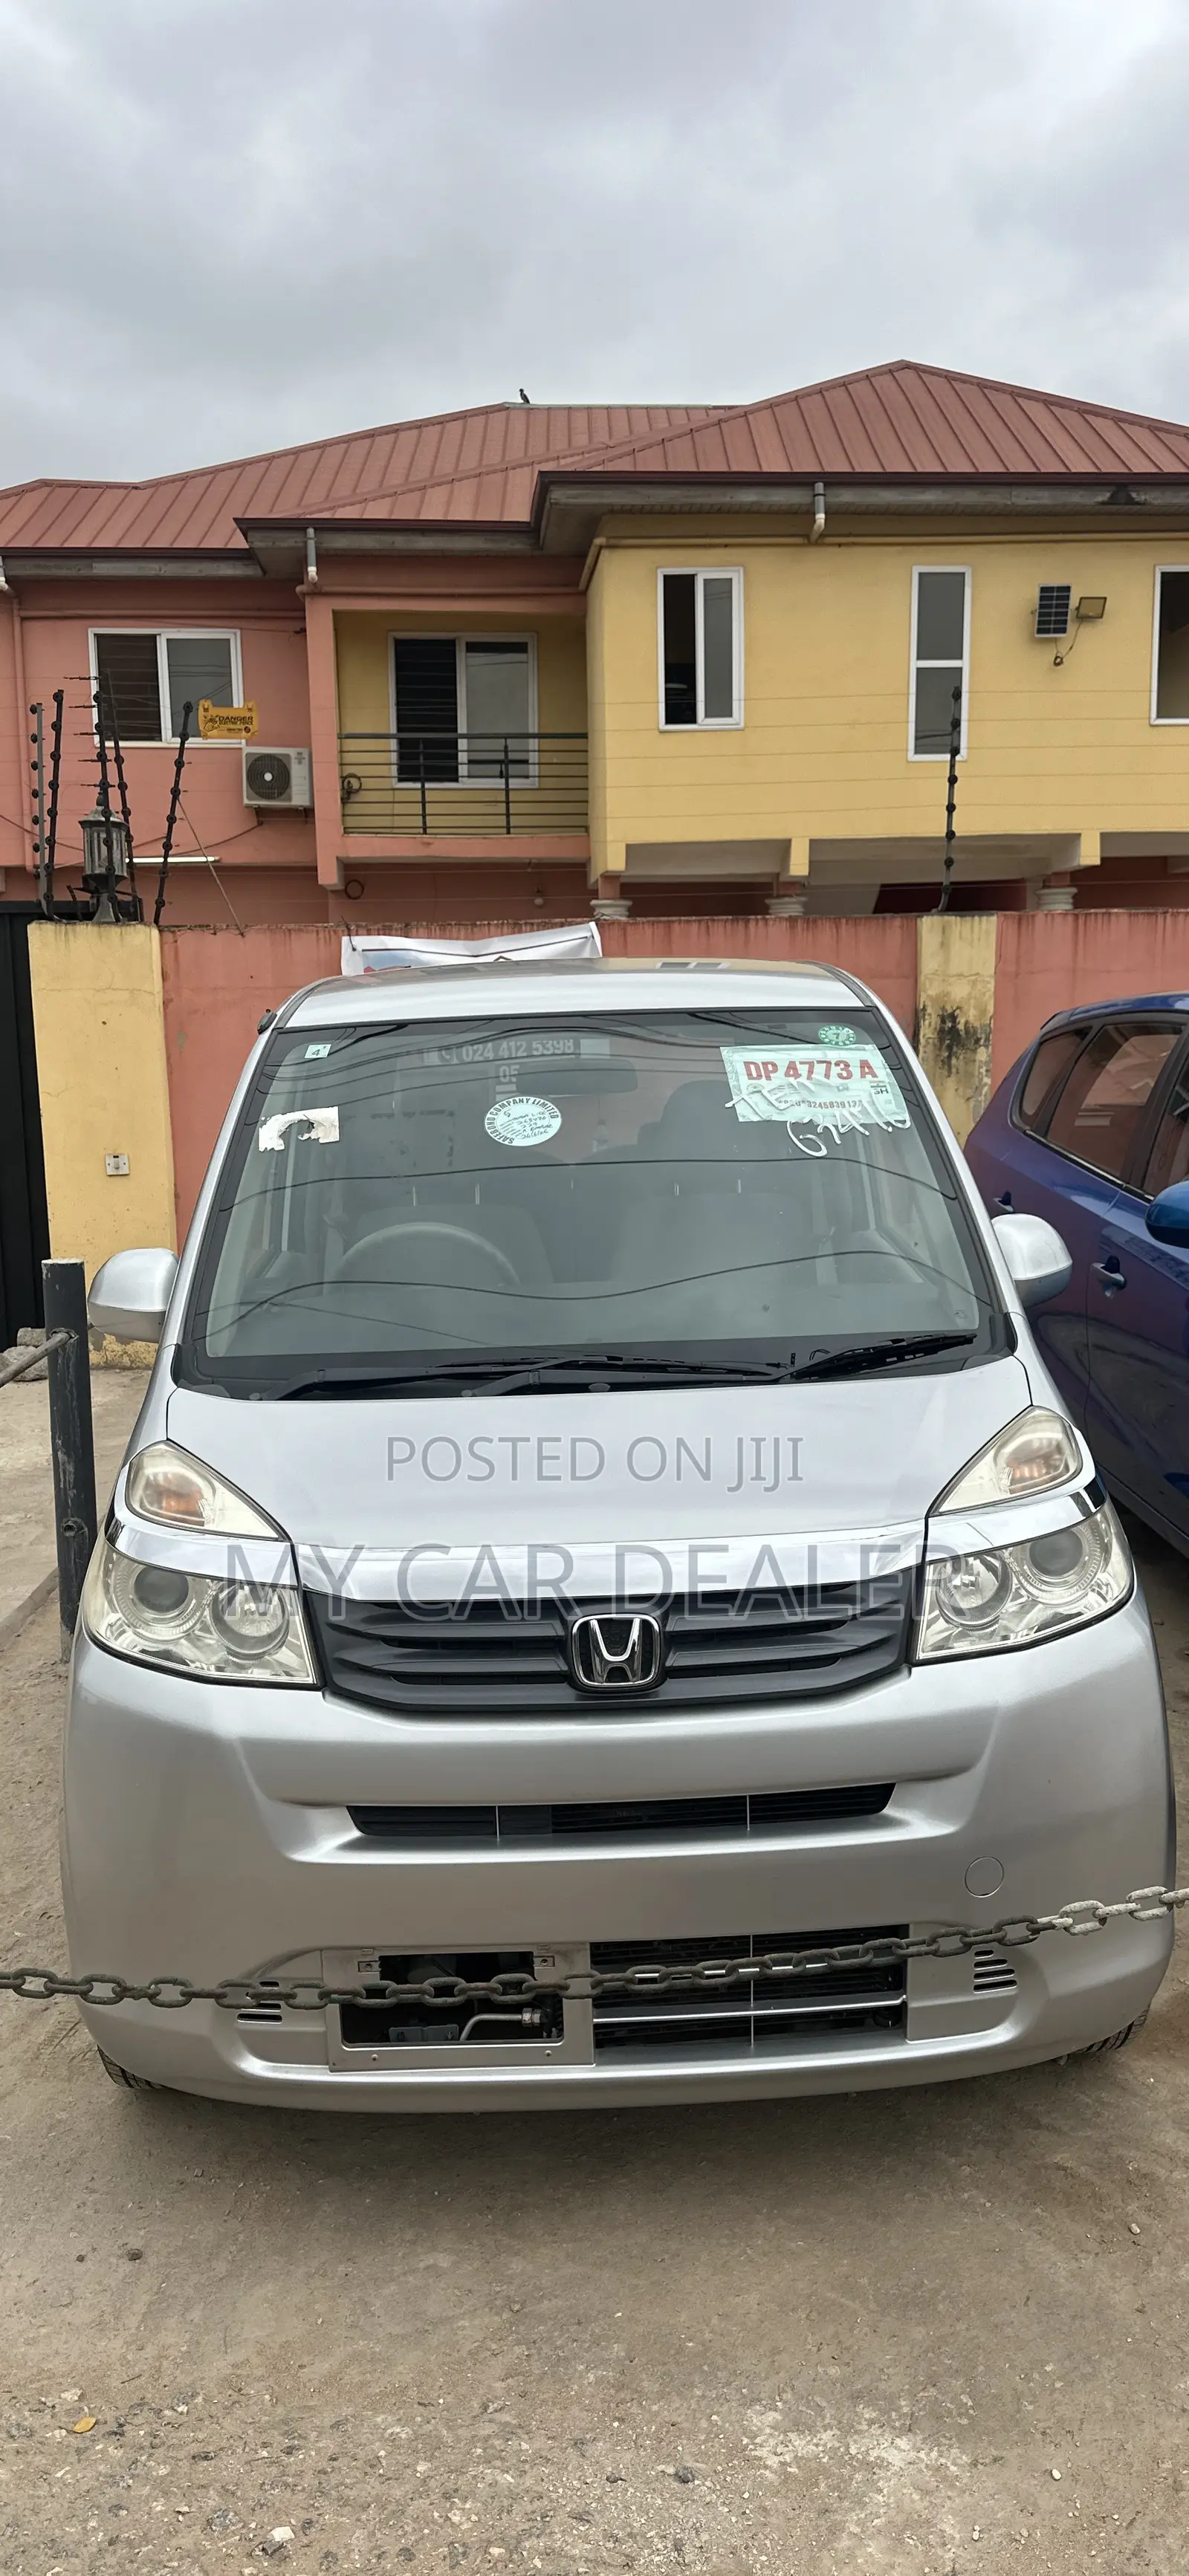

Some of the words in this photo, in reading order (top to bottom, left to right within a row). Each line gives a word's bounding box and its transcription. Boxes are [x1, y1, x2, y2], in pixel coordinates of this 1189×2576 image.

[311, 1048, 320, 1057] 4
[462, 1042, 494, 1062] 024
[498, 1040, 527, 1058] 412
[532, 1039, 574, 1055] 5398
[743, 1061, 778, 1081] DP
[784, 1060, 853, 1081] 4773
[859, 1059, 878, 1079] A
[489, 1097, 531, 1116] COMPANY
[531, 1098, 560, 1119] LIMITED
[486, 1117, 515, 1145] SAFEBOND
